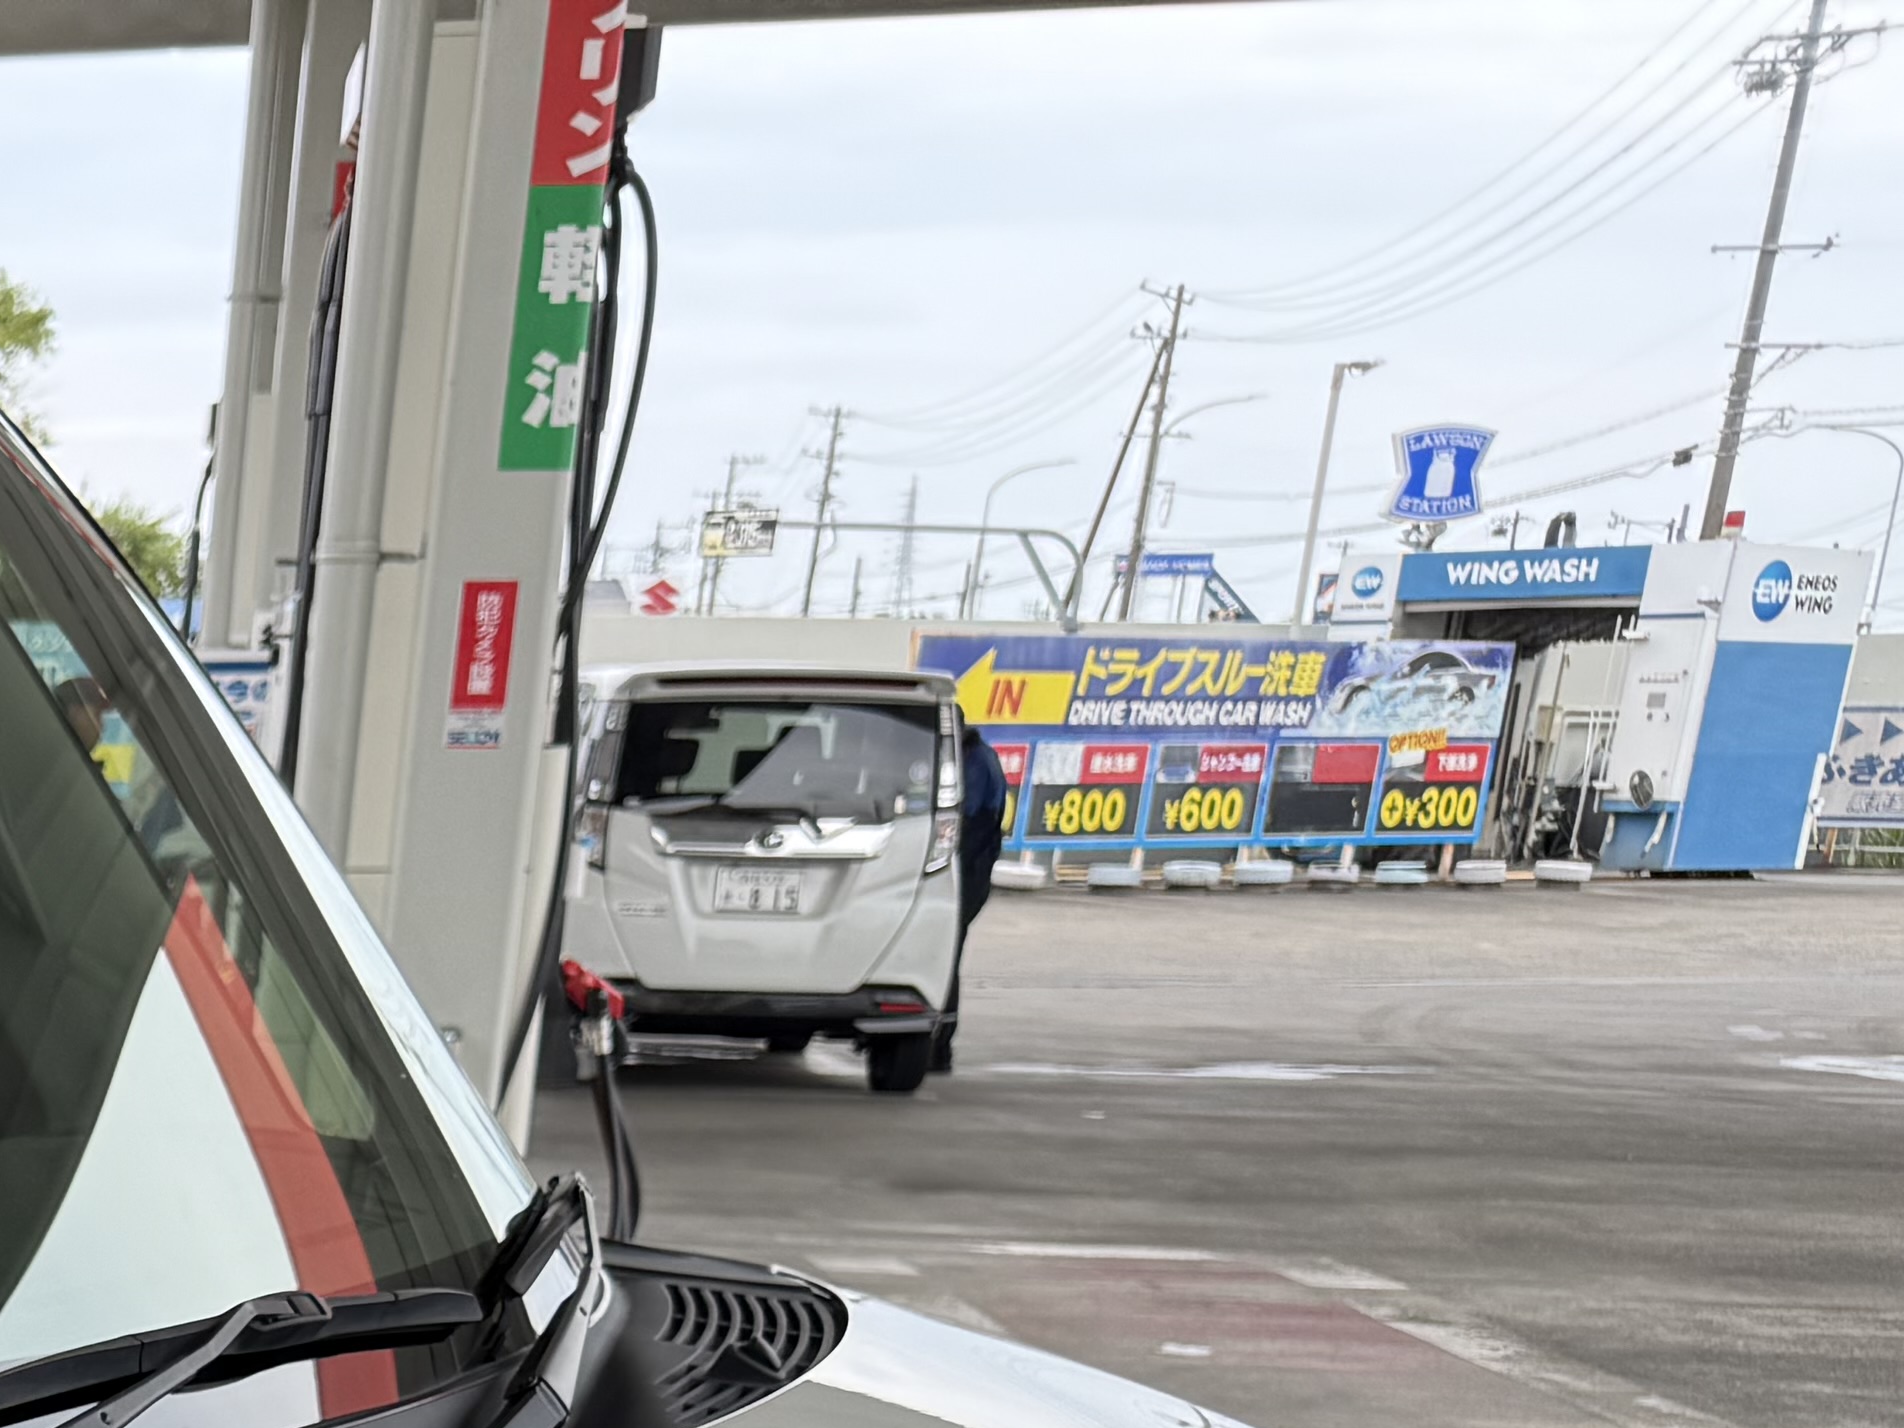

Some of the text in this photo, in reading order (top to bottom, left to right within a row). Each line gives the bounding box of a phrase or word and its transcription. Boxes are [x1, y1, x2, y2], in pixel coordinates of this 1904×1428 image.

[1408, 432, 1484, 452] LAWSON
[1398, 495, 1472, 514] STATION
[1447, 558, 1599, 586] WING WASH
[1797, 575, 1839, 592] ENEOS
[1794, 595, 1832, 615] WING
[1078, 644, 1327, 698] ドライブスルー洗車
[986, 678, 1026, 718] IN
[1068, 700, 1312, 726] DRIVE THROUGH CAR WASH
[1043, 788, 1127, 834] ¥800
[1164, 787, 1245, 832] ¥600
